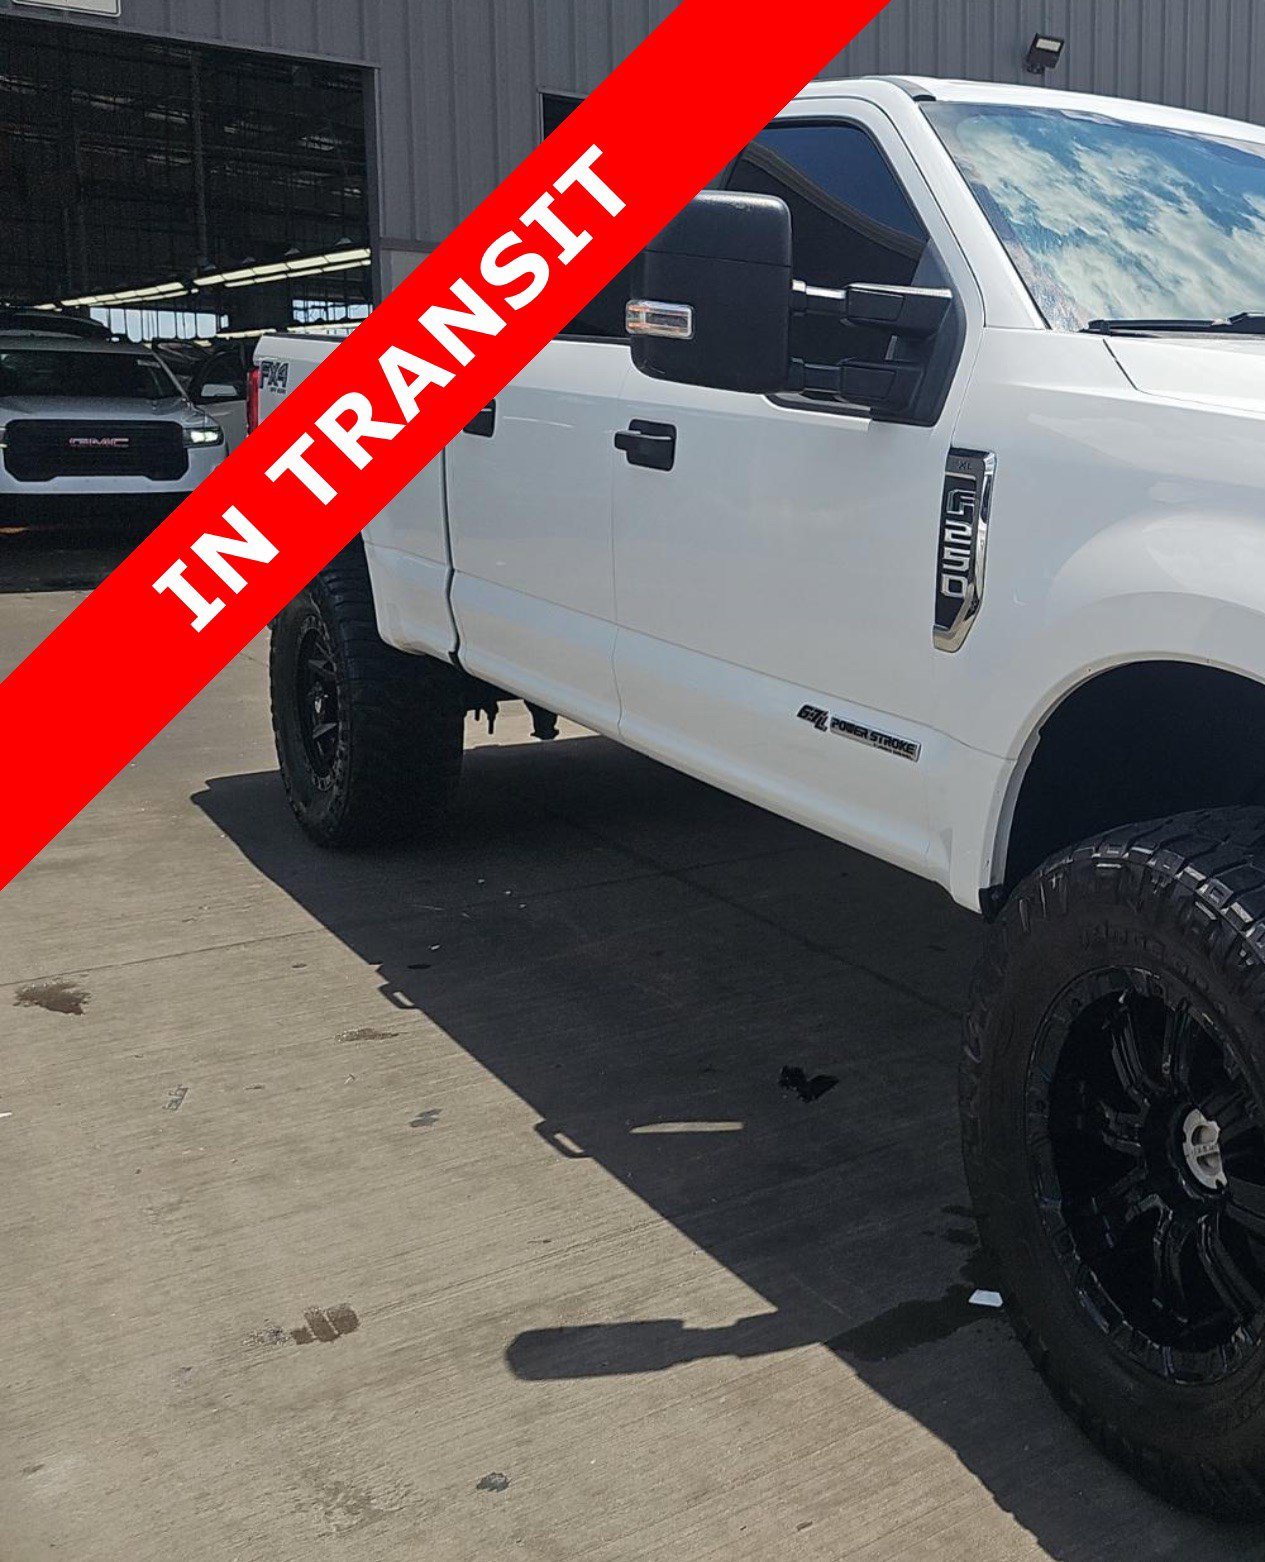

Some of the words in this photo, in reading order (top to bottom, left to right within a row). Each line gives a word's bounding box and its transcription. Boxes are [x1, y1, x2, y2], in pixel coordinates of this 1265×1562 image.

[260, 361, 289, 388] FX4
[69, 438, 129, 448] GMC
[831, 717, 869, 740] POWER
[870, 731, 917, 755] STROKE
